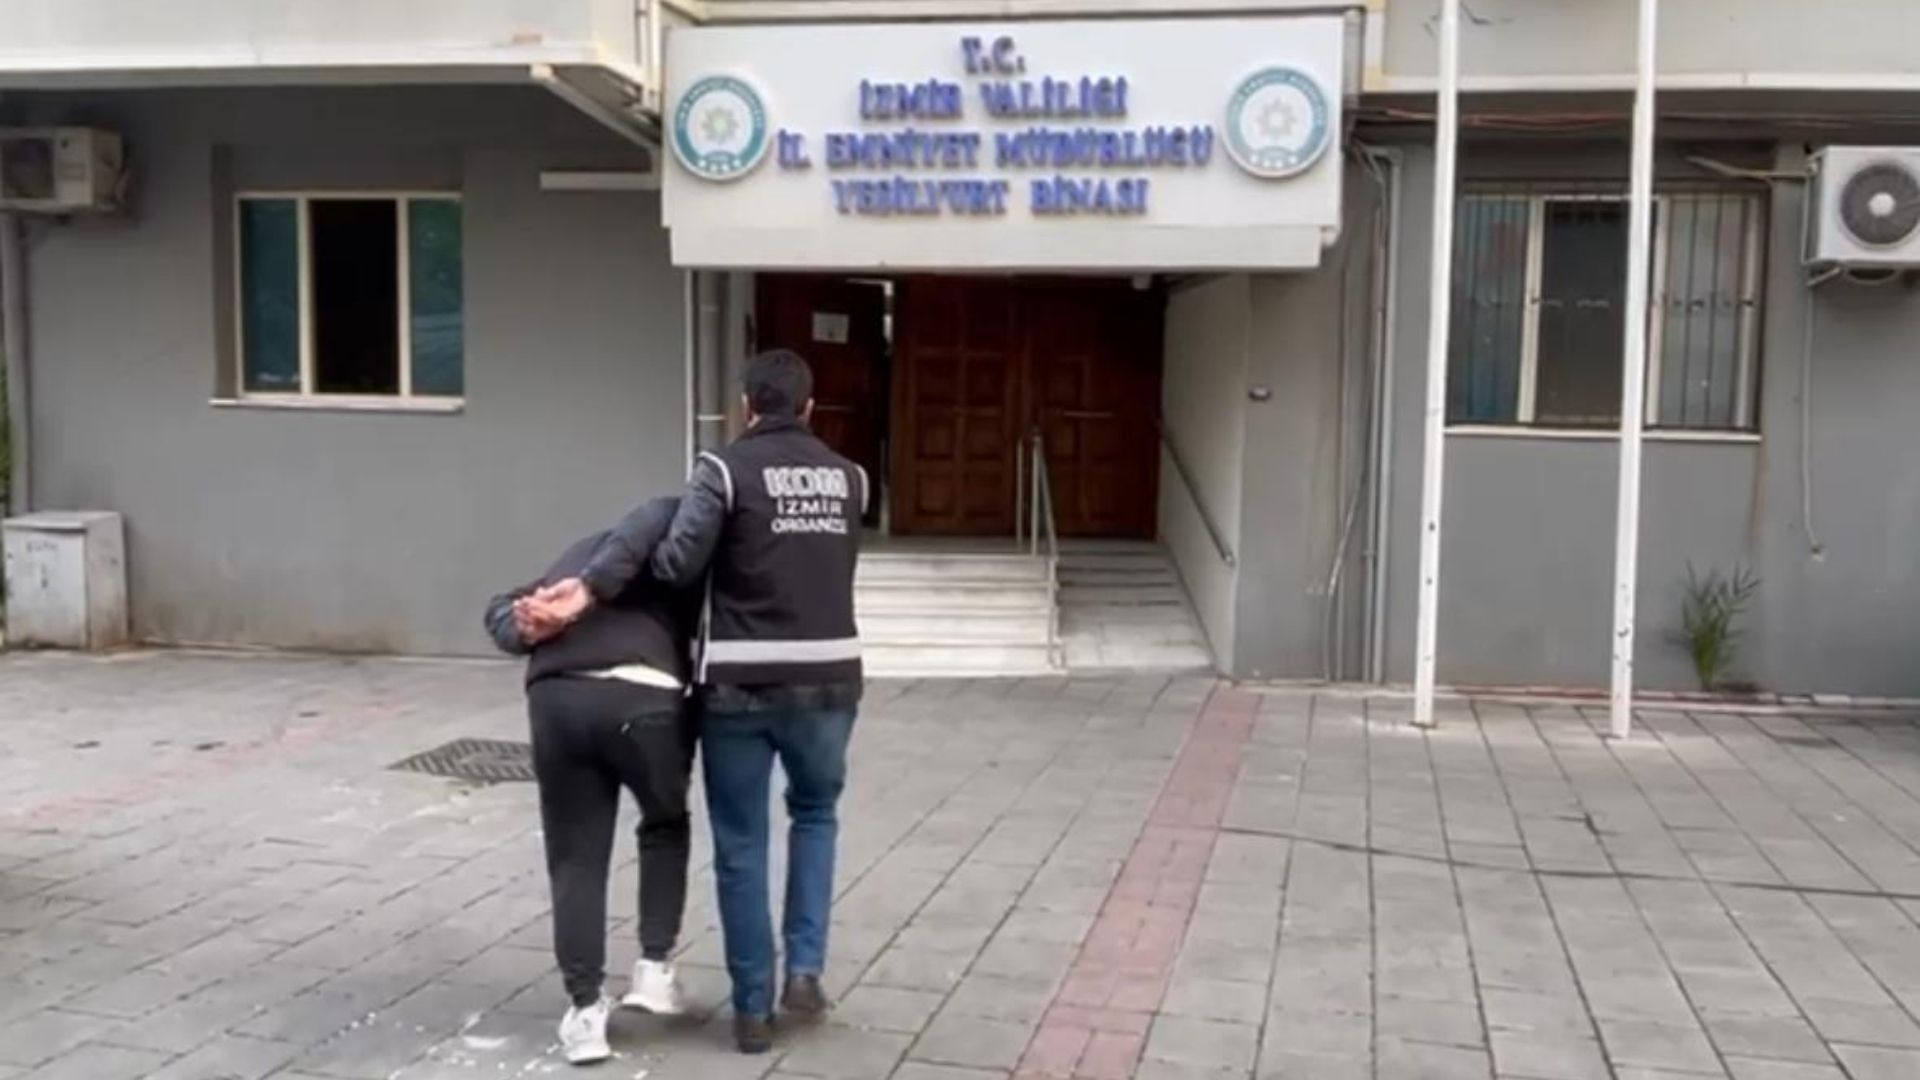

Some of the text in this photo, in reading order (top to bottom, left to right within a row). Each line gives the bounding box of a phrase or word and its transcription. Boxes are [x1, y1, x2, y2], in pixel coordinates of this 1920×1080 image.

[960, 36, 1026, 75] T.C.
[859, 78, 963, 121] İZMİR
[825, 128, 980, 168] EMNİYET
[1030, 176, 1149, 217] BİNASI
[763, 466, 848, 498] KOM
